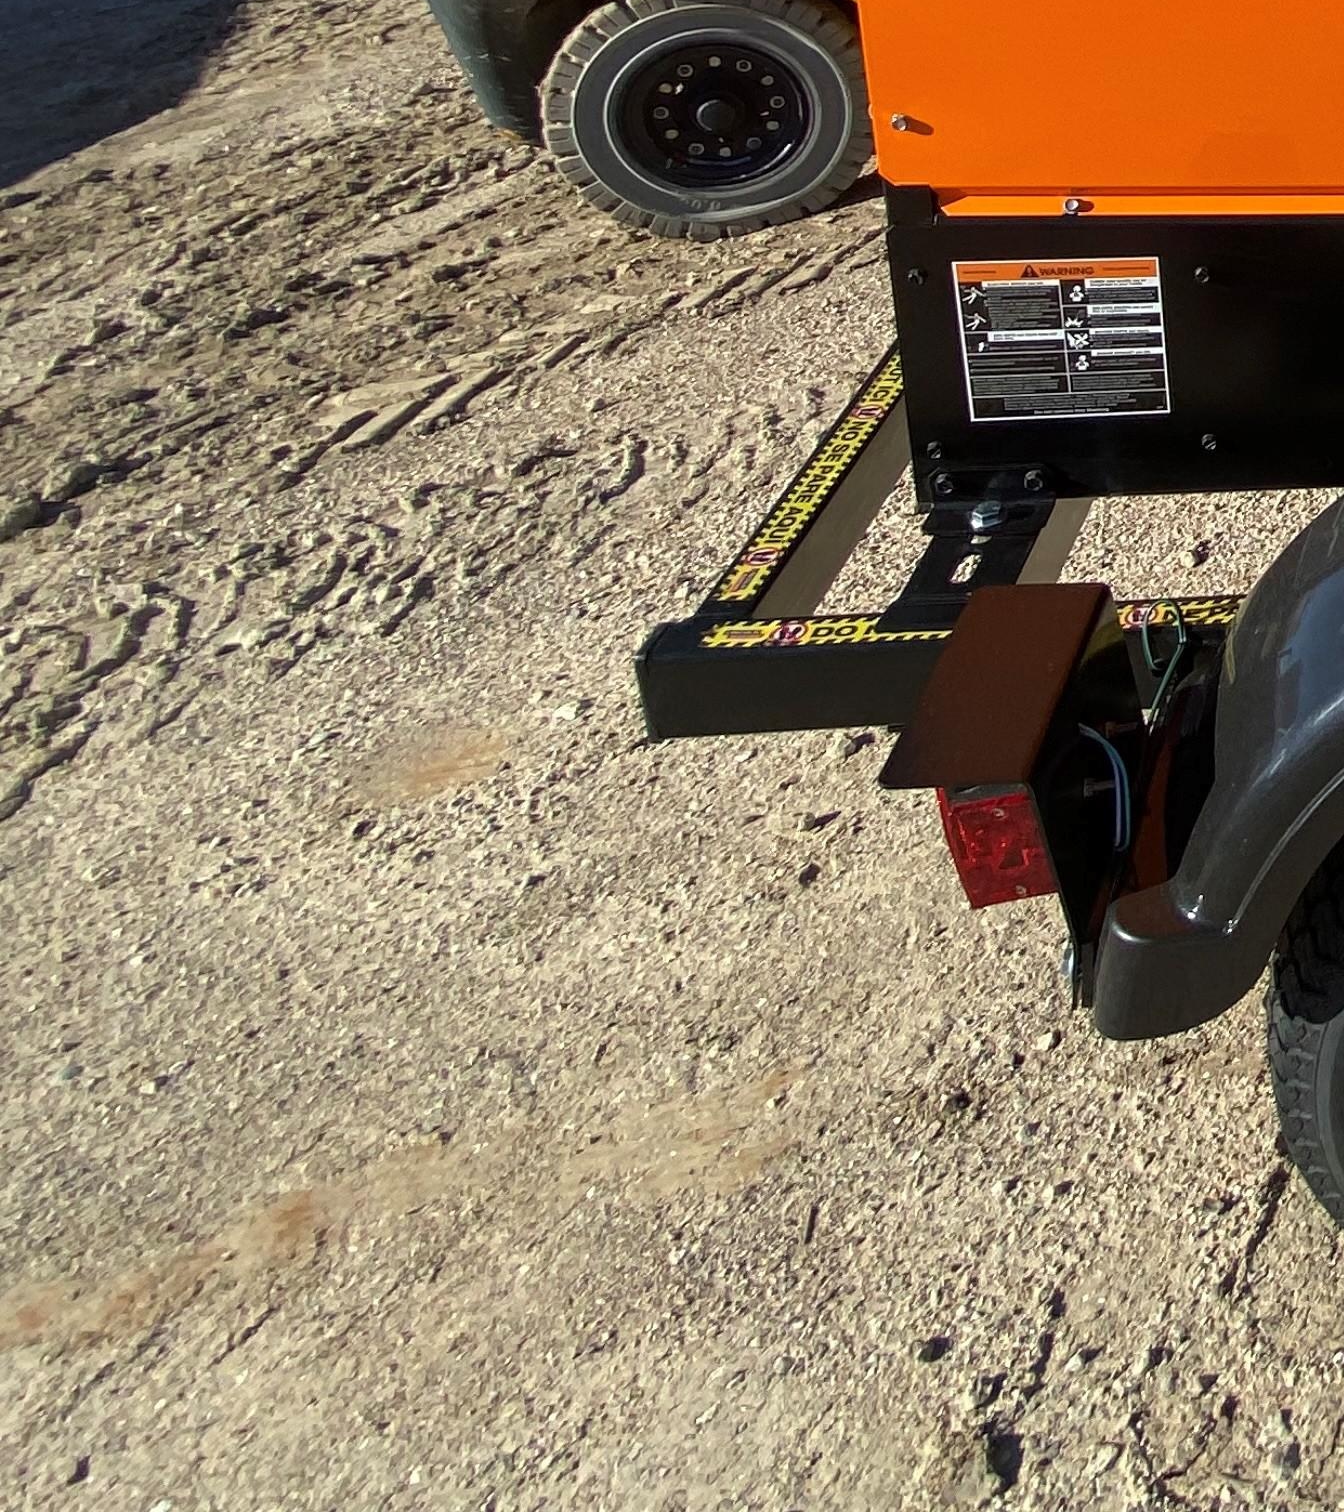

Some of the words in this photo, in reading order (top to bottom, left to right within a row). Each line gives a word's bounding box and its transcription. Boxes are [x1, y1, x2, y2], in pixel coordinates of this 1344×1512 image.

[1039, 266, 1095, 277] WARNING
[841, 420, 865, 442] NO
[825, 443, 849, 463] SE
[794, 464, 834, 504] PARE
